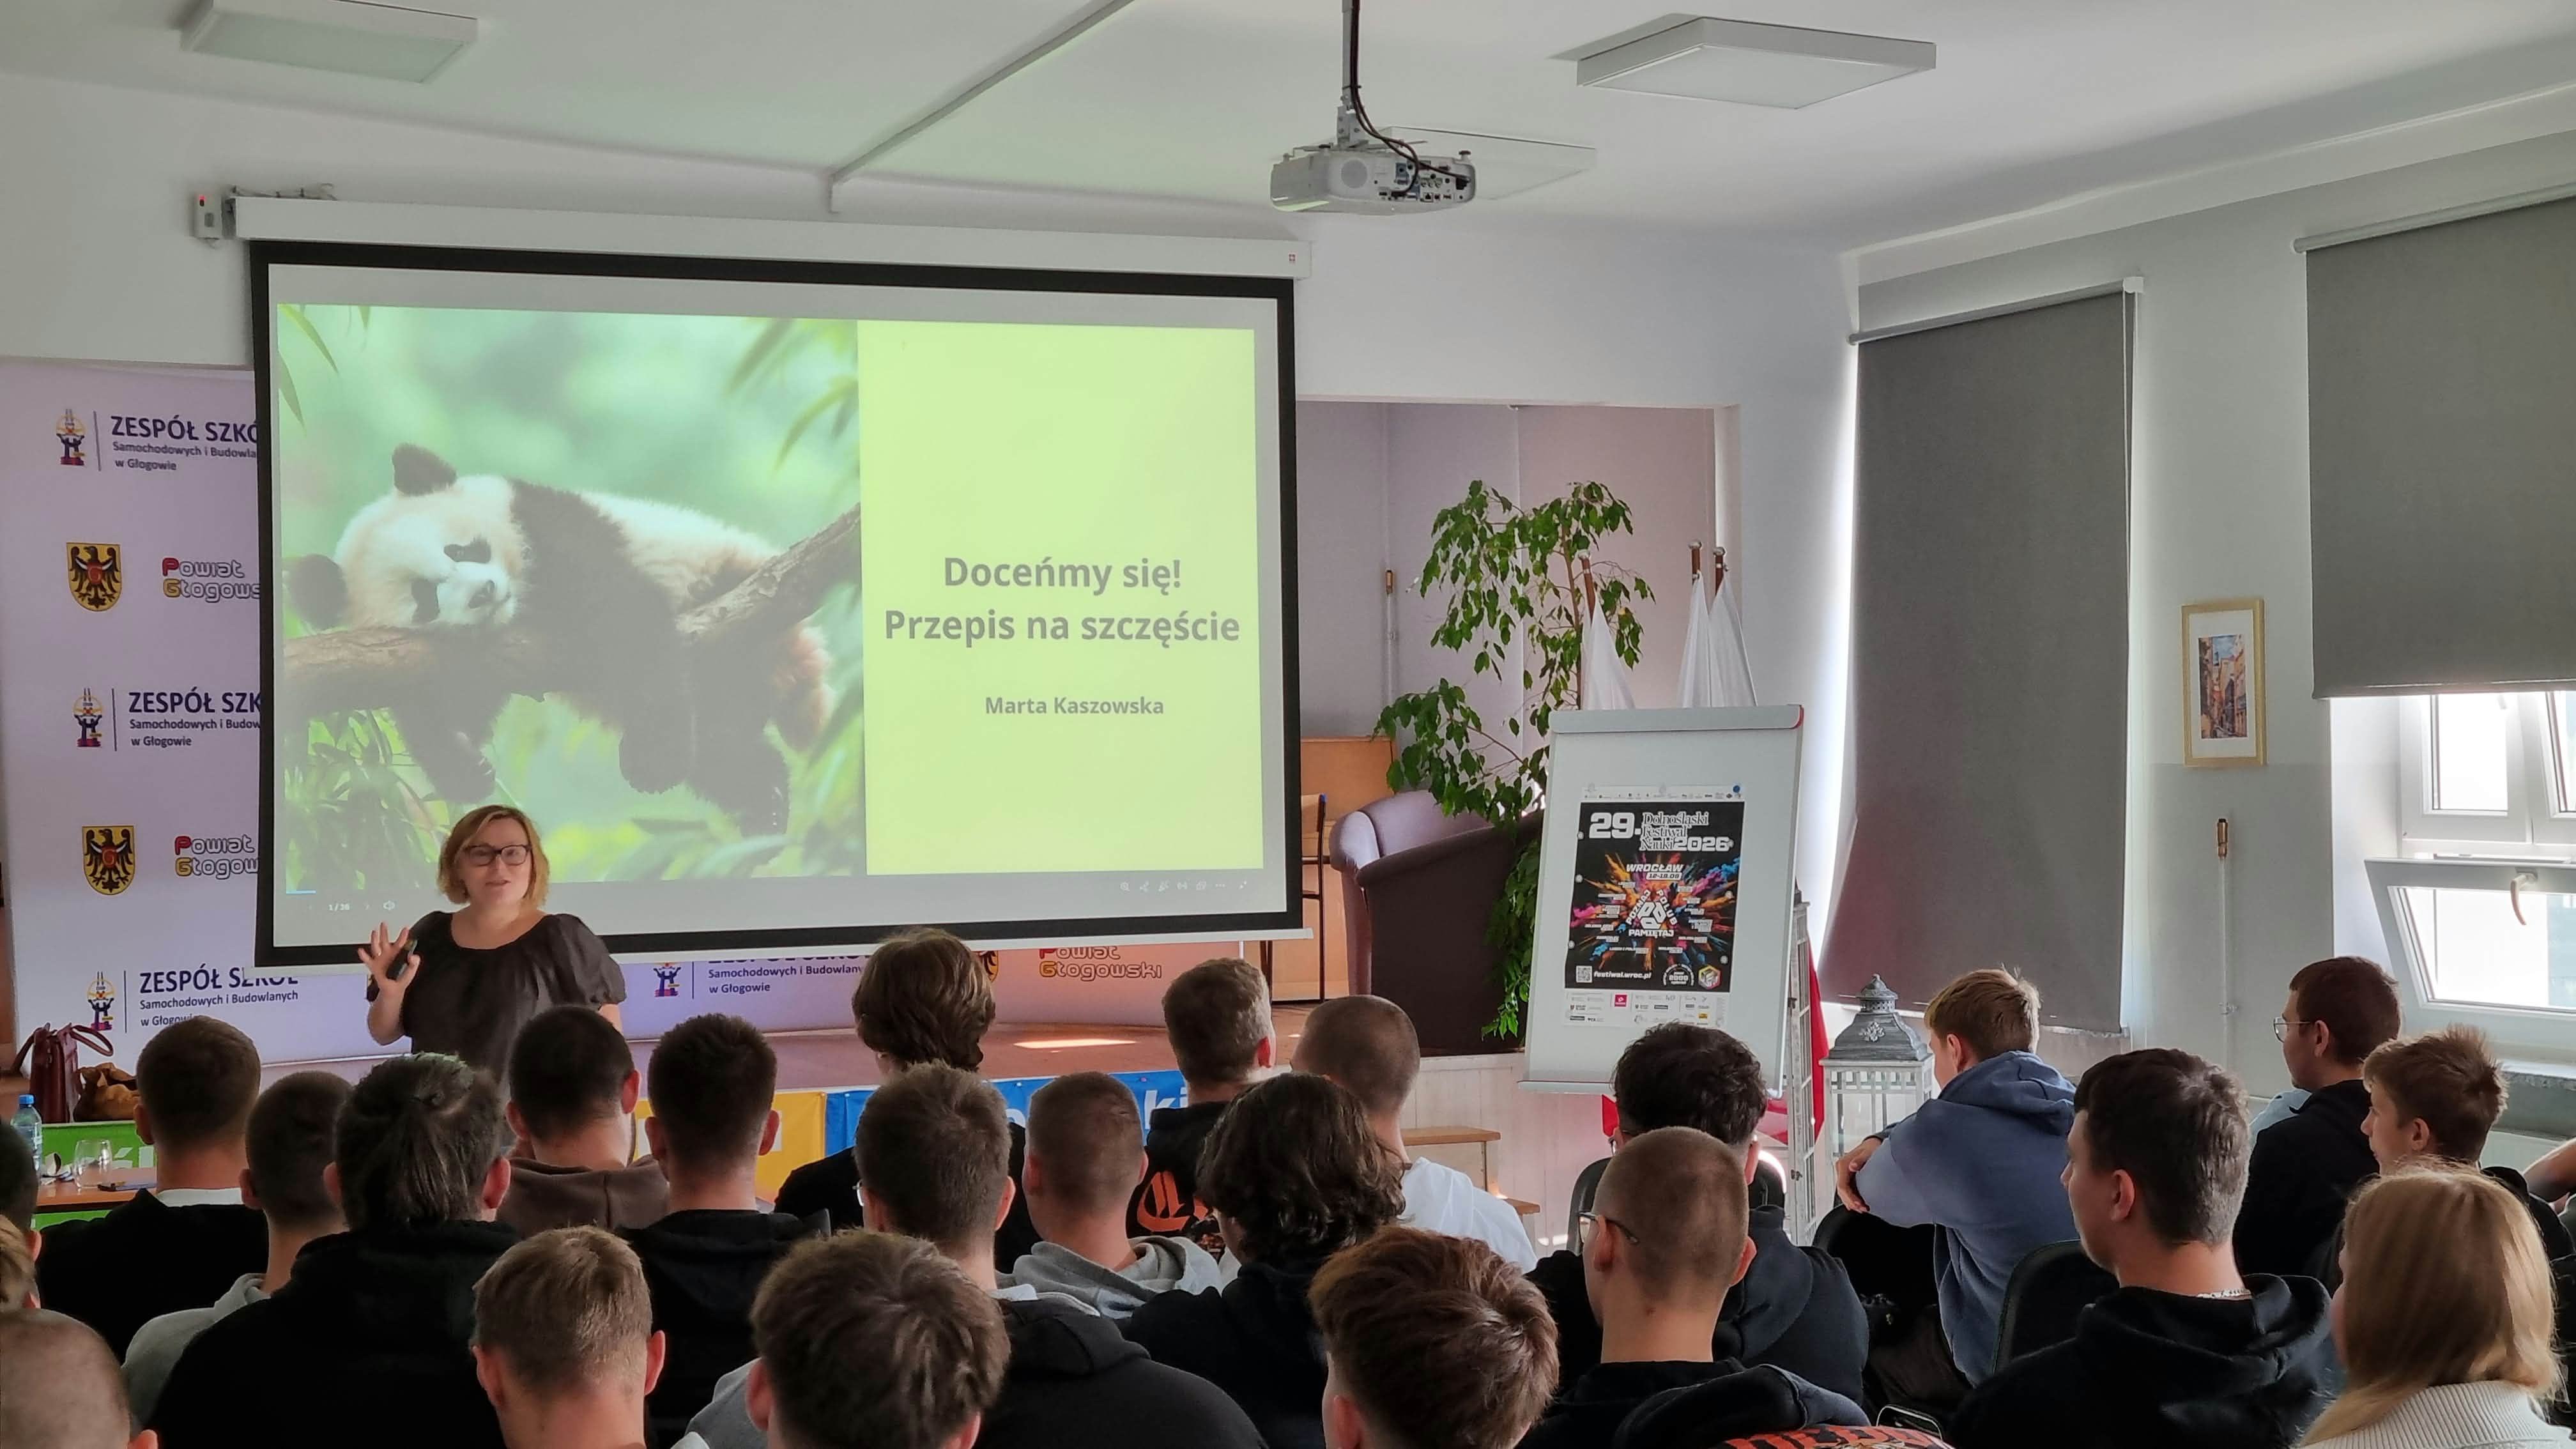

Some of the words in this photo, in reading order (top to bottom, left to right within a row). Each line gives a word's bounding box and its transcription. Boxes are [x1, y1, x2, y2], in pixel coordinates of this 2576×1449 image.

[111, 415, 199, 441] ZESPÓŁ
[206, 420, 257, 444] SZKÓ
[112, 441, 202, 457] Samochodowych
[204, 447, 208, 456] i
[210, 447, 257, 459] Budowla
[127, 459, 177, 471] Głogowie
[162, 557, 245, 578] Powiat
[944, 557, 1112, 595] Doceńmy
[1123, 558, 1181, 595] się!
[162, 578, 261, 602] Głogows
[885, 609, 1016, 648] Przepis
[1027, 616, 1069, 640] na
[1081, 610, 1239, 648] szczęście
[128, 687, 215, 714] ZESPÓŁ
[222, 692, 261, 714] SZK
[985, 697, 1047, 714] Marta
[1054, 697, 1164, 714] Kaszowska
[130, 719, 217, 732] Samochodowych
[220, 719, 222, 729] i
[226, 719, 261, 730] Budow
[132, 738, 141, 746] w
[143, 735, 192, 748] Głogowie
[1589, 812, 1641, 839] 29.
[1642, 811, 1709, 829] Dolnośląski
[1641, 825, 1688, 838] Festiwal
[174, 834, 256, 854] Powiat
[1639, 838, 1674, 851] Nauki
[1673, 836, 1730, 851] 2026
[174, 857, 260, 879] Głogow
[1626, 864, 1683, 872] WROCŁAW
[1625, 889, 1651, 925] POZNAJ
[1656, 889, 1678, 926] POLUB
[1629, 929, 1674, 937] PAMIĘTAJ
[139, 963, 223, 994] ZESPÓŁ
[708, 966, 797, 979] Samochodowych
[800, 966, 802, 974] i
[806, 965, 862, 975] Budowlan
[1593, 970, 1652, 980] festiwal.wroc.pl
[721, 983, 770, 995] Głogowie
[139, 994, 223, 1010] Samochodowych
[226, 993, 229, 1004] i
[232, 990, 298, 1004] Budowlanych
[152, 1013, 193, 1026] Głogowi
